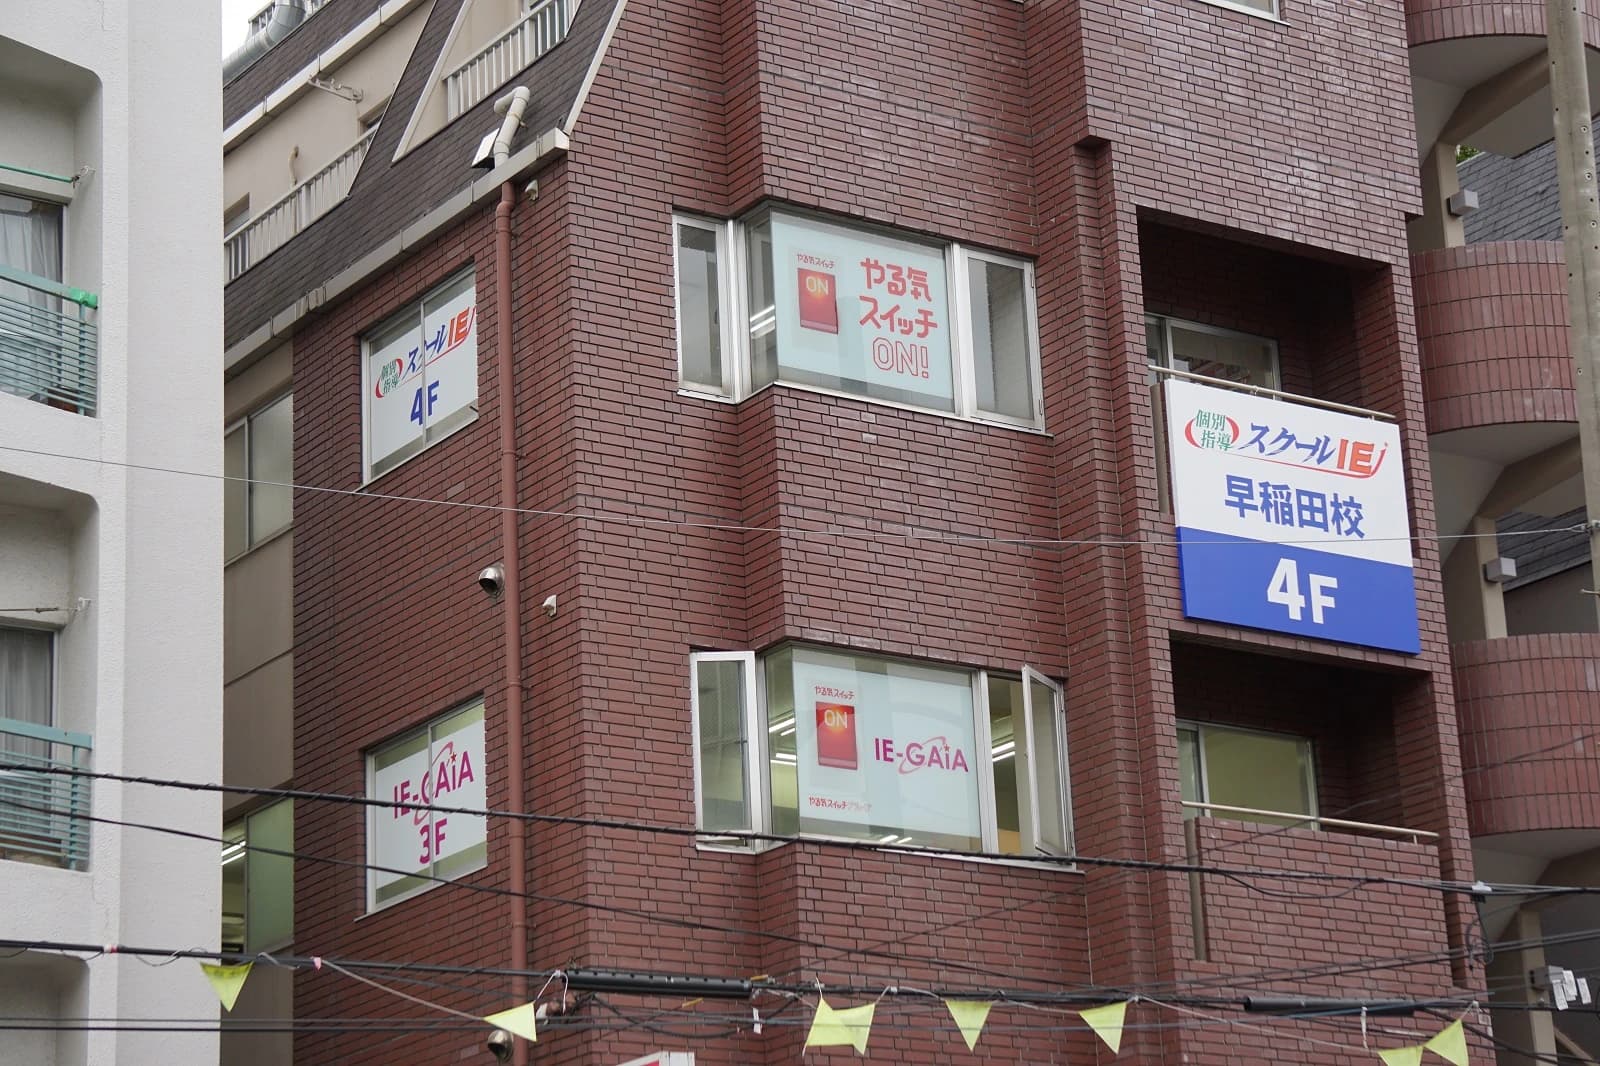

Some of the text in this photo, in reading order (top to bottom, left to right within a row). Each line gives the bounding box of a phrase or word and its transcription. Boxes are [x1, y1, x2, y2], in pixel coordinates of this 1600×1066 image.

[806, 276, 829, 296] ON
[860, 257, 932, 302] やる気
[859, 295, 938, 338] スイッチ
[872, 337, 929, 379] ON!
[410, 380, 439, 426] 4F
[1195, 409, 1226, 431] 個別
[1201, 430, 1233, 452] 指導
[1224, 474, 1365, 538] 早稲田校
[1266, 557, 1338, 625] 4F
[824, 709, 848, 729] ON
[419, 818, 448, 865] 3F
